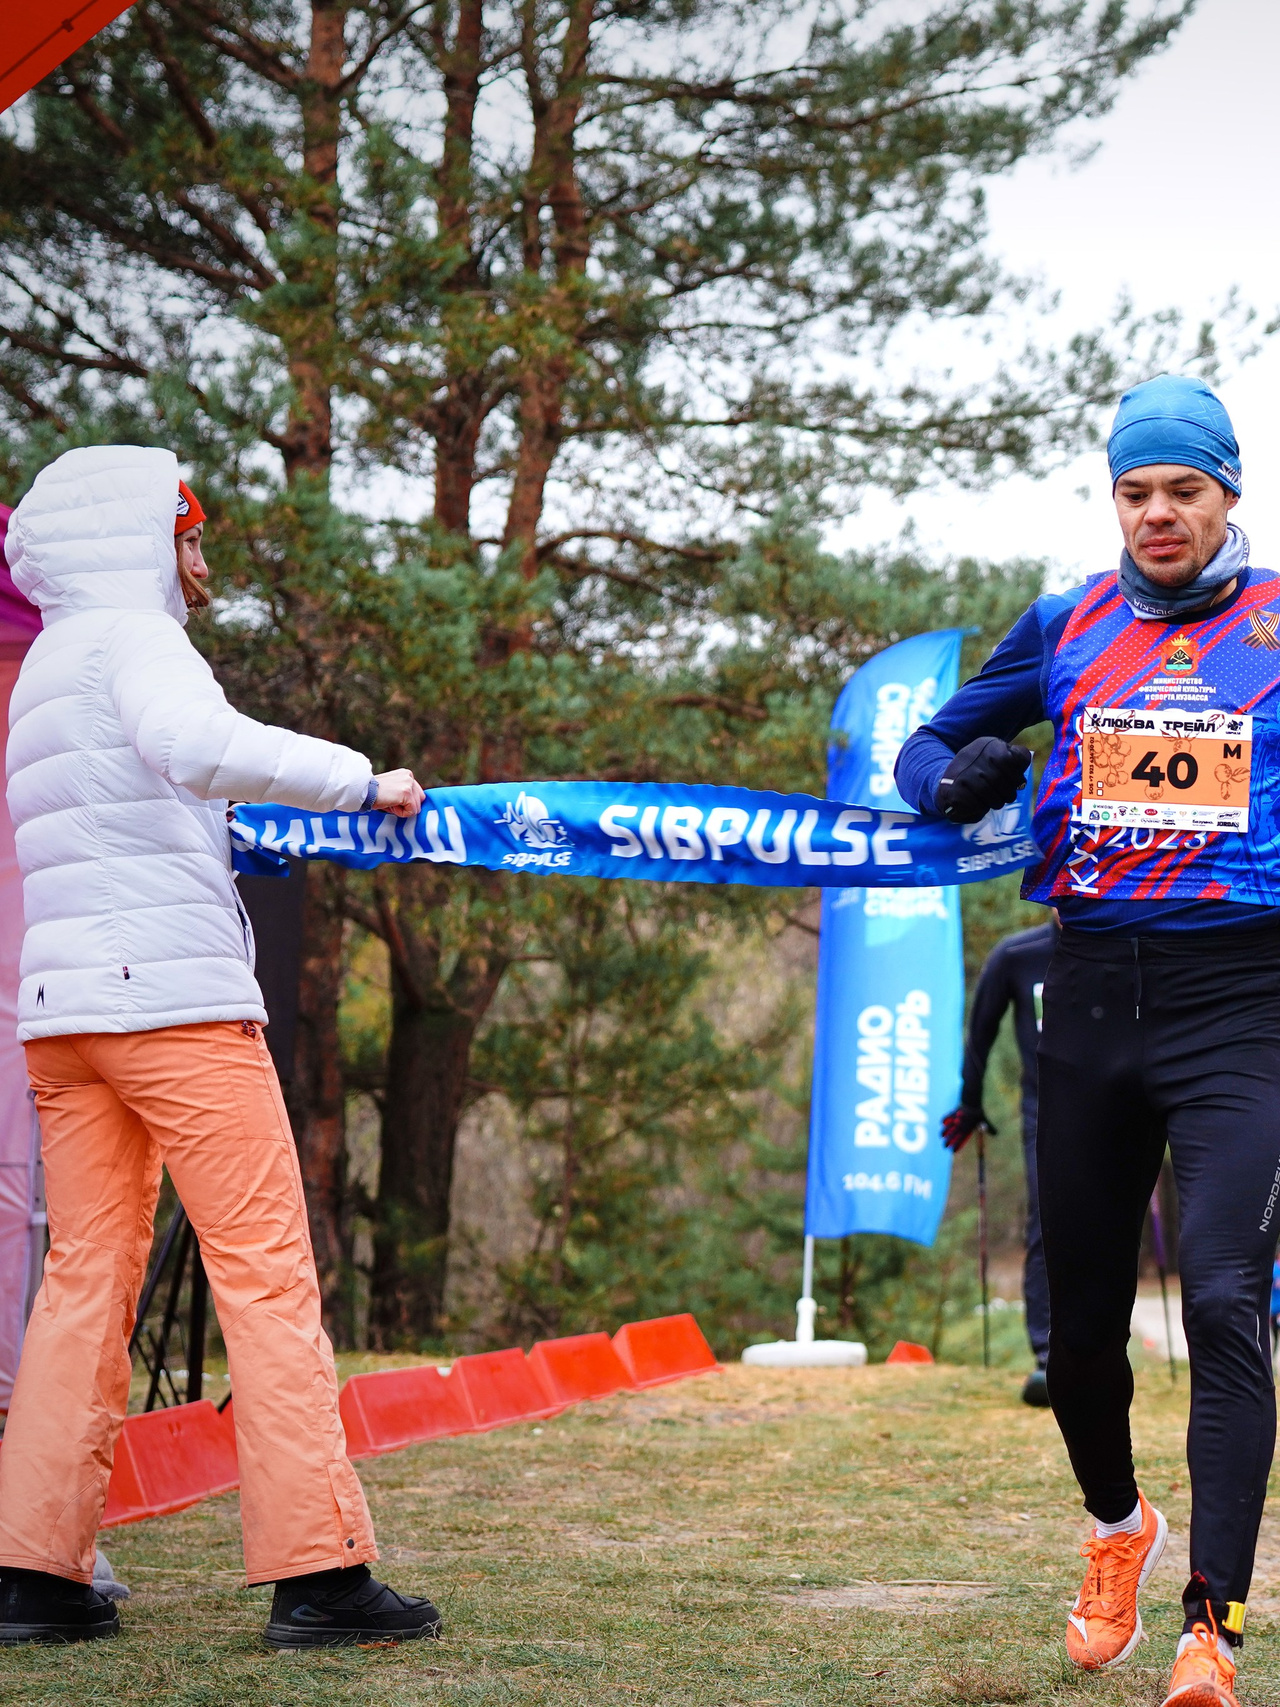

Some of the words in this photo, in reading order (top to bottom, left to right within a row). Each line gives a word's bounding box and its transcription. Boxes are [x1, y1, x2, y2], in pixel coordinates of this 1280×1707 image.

[1091, 718, 1155, 730] КЛЮКВА
[1163, 719, 1216, 733] ТРЕЙЛ
[1131, 751, 1199, 789] 40
[599, 803, 916, 867] SIBPULSE
[1104, 825, 1207, 850] 2023
[854, 1004, 894, 1147] РАДИО
[893, 989, 932, 1154] СИБИРЬ
